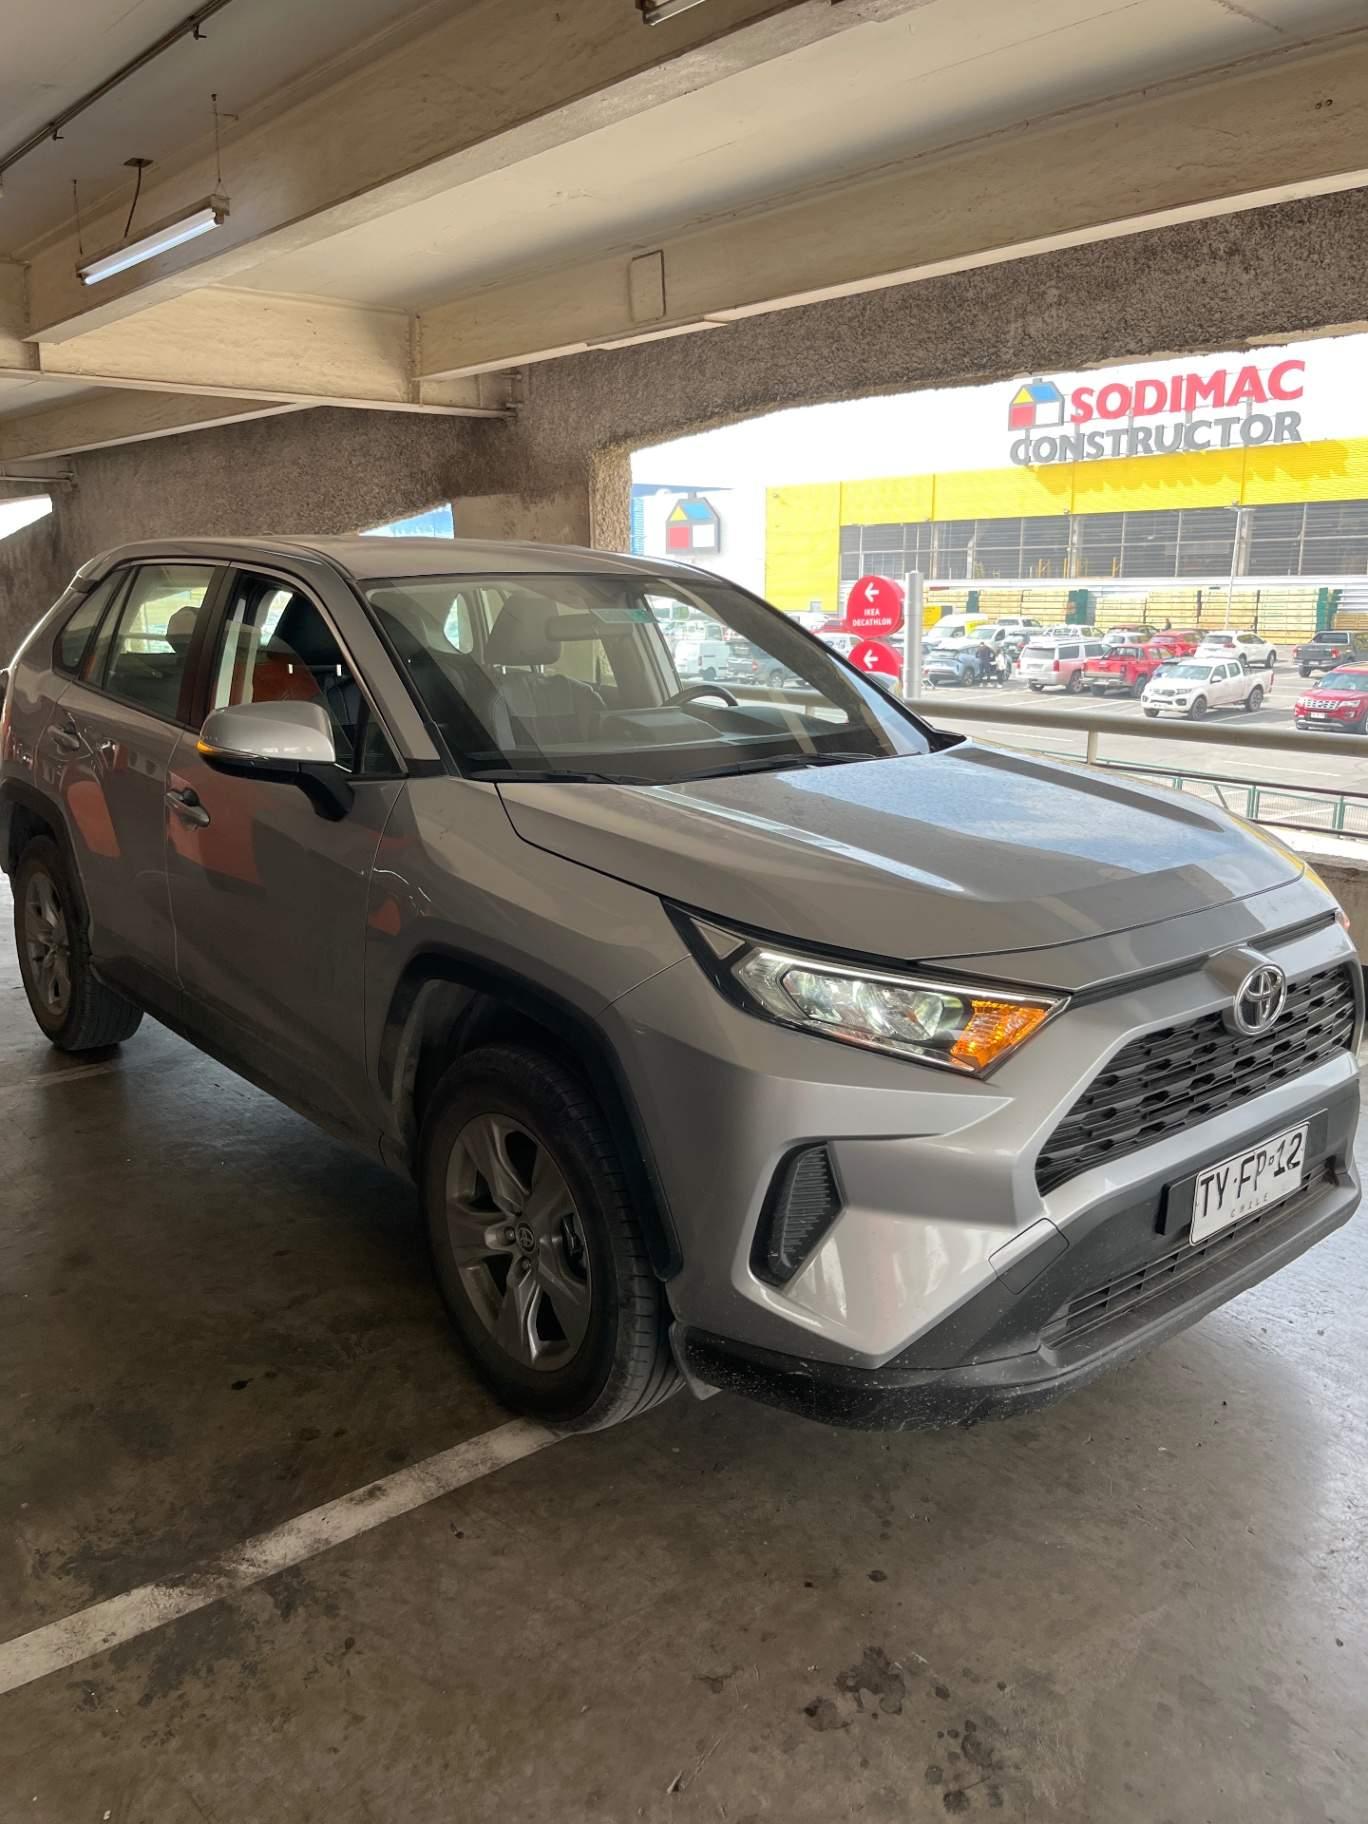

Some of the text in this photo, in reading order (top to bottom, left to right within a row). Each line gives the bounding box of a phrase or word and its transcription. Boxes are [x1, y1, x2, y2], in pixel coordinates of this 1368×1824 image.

[1070, 359, 1305, 424] SODIMAC
[1009, 411, 1302, 466] CONSTRUCTOR
[852, 617, 892, 627] DECATHLON
[863, 608, 880, 616] IKEA
